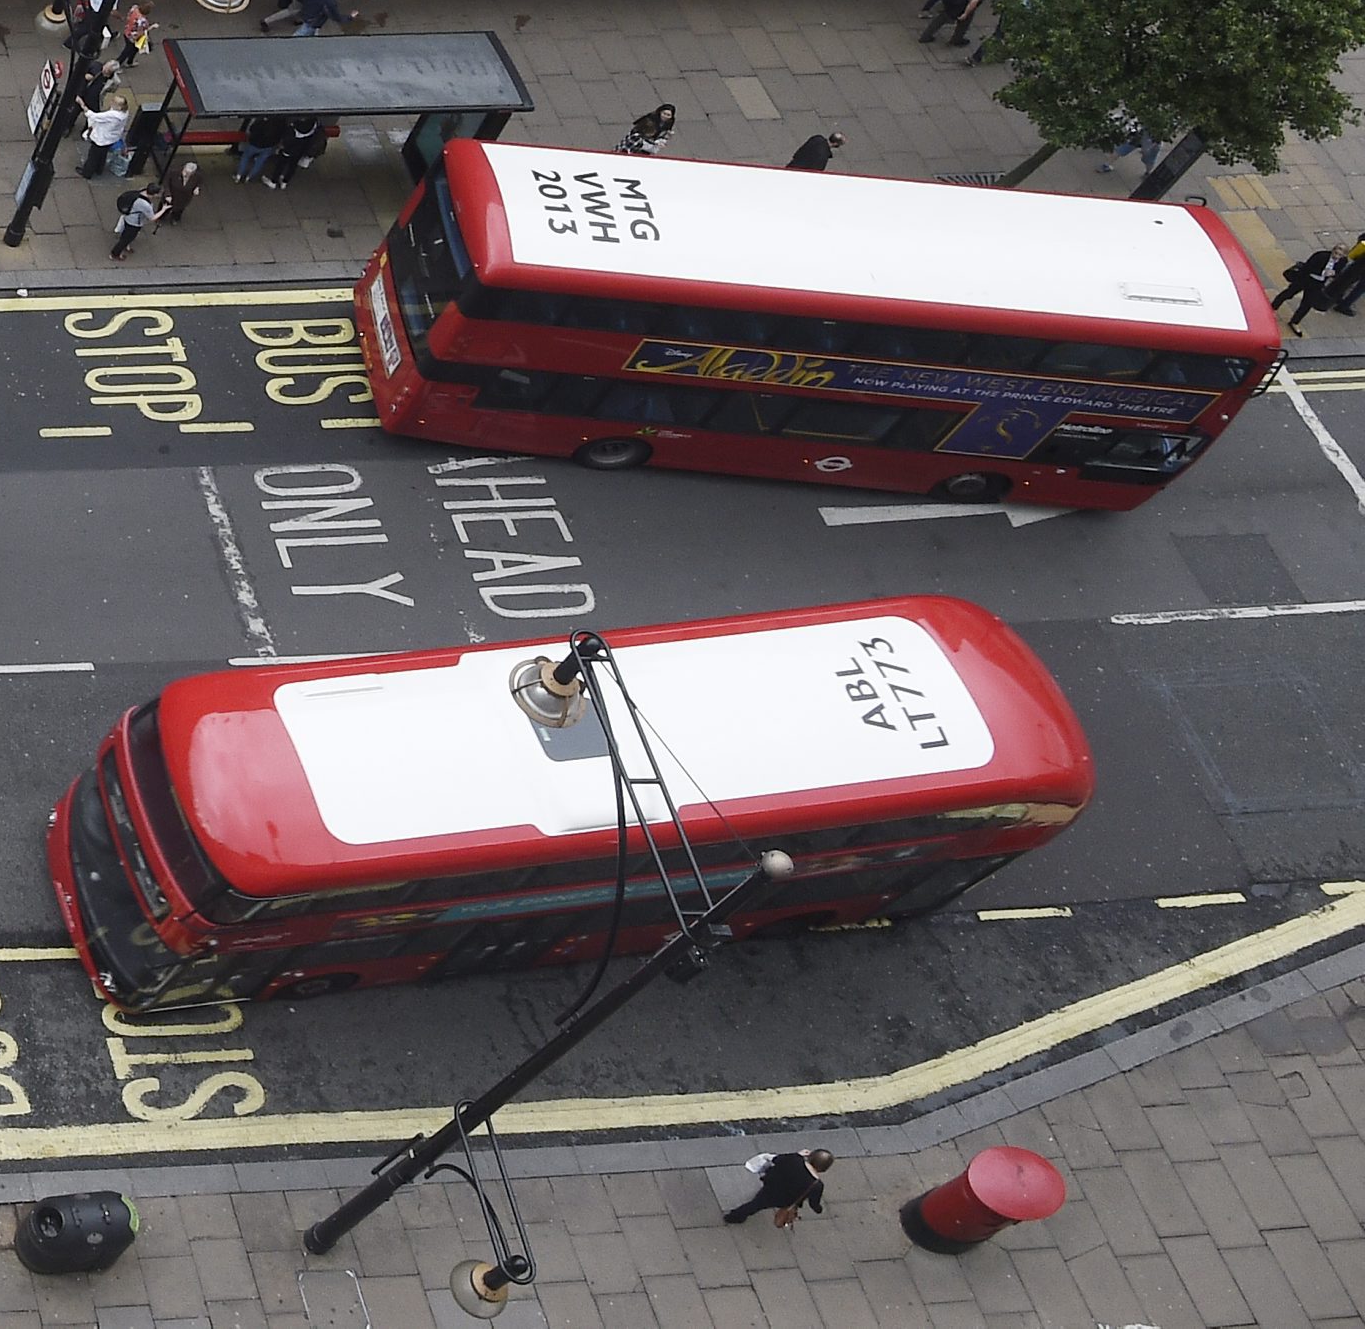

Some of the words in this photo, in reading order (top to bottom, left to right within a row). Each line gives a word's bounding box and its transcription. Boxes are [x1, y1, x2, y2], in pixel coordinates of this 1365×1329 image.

[531, 170, 578, 235] 2013
[573, 172, 620, 244] VWH
[613, 177, 660, 242] MTG
[64, 310, 203, 422] STOP
[240, 318, 373, 405] BUS
[635, 348, 836, 387] Aladdin
[848, 364, 895, 380] THE
[900, 370, 958, 384] NEW
[967, 376, 1034, 391] WEST
[1038, 384, 1090, 398] END
[1096, 389, 1201, 408] MUSICAL
[853, 377, 888, 387] NOW
[891, 381, 949, 394] PLAYING
[950, 386, 971, 395] AT
[973, 389, 998, 398] THE
[1001, 391, 1050, 402] PRINCE
[1053, 395, 1113, 409] EDWARD
[1117, 403, 1178, 415] THEATRE
[254, 464, 415, 607] ONLY
[835, 657, 898, 731] ABL
[857, 637, 950, 749] LT773
[97, 995, 268, 1121] STO
